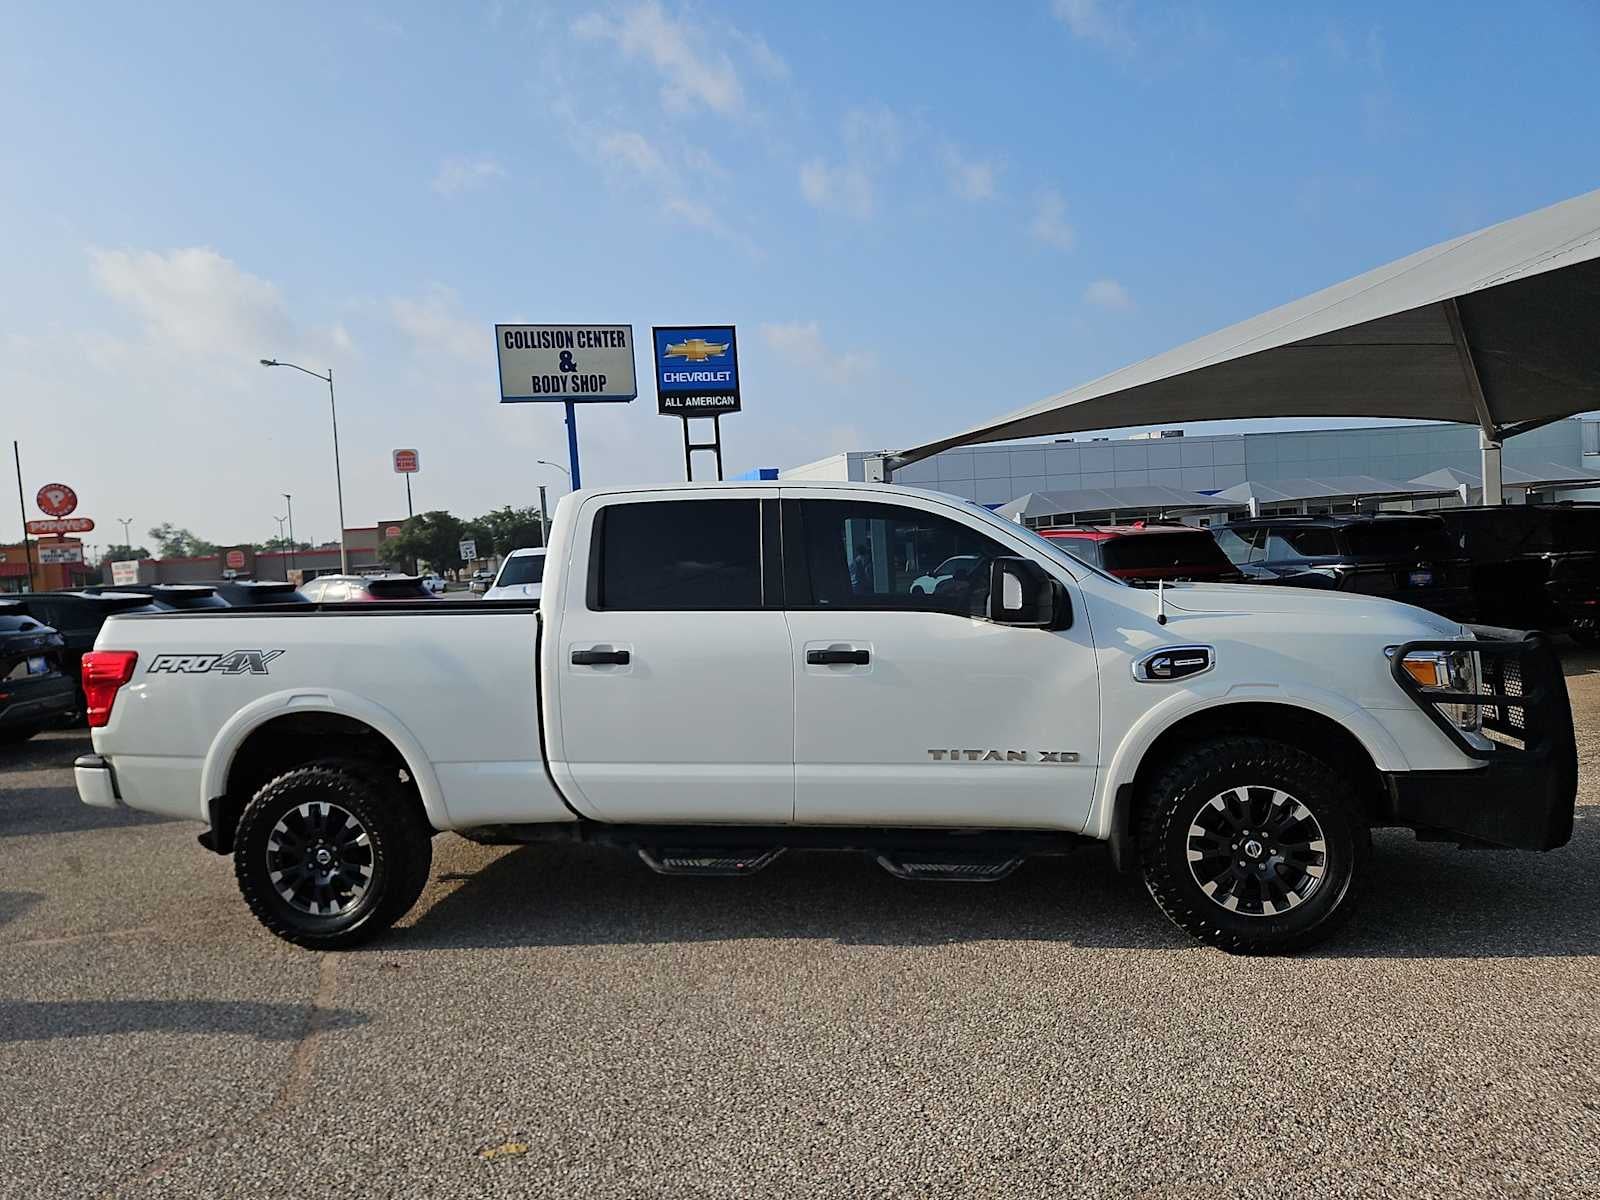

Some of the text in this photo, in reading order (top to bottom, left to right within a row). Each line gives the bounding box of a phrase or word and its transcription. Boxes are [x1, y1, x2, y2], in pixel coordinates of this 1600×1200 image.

[504, 329, 626, 350] COLLISION CENTER
[559, 350, 577, 373] &
[532, 374, 607, 393] BODY SHOP
[663, 371, 731, 383] CHEVROLET
[665, 395, 735, 407] ALL AMERICAN
[928, 749, 1081, 763] TITAN XD
